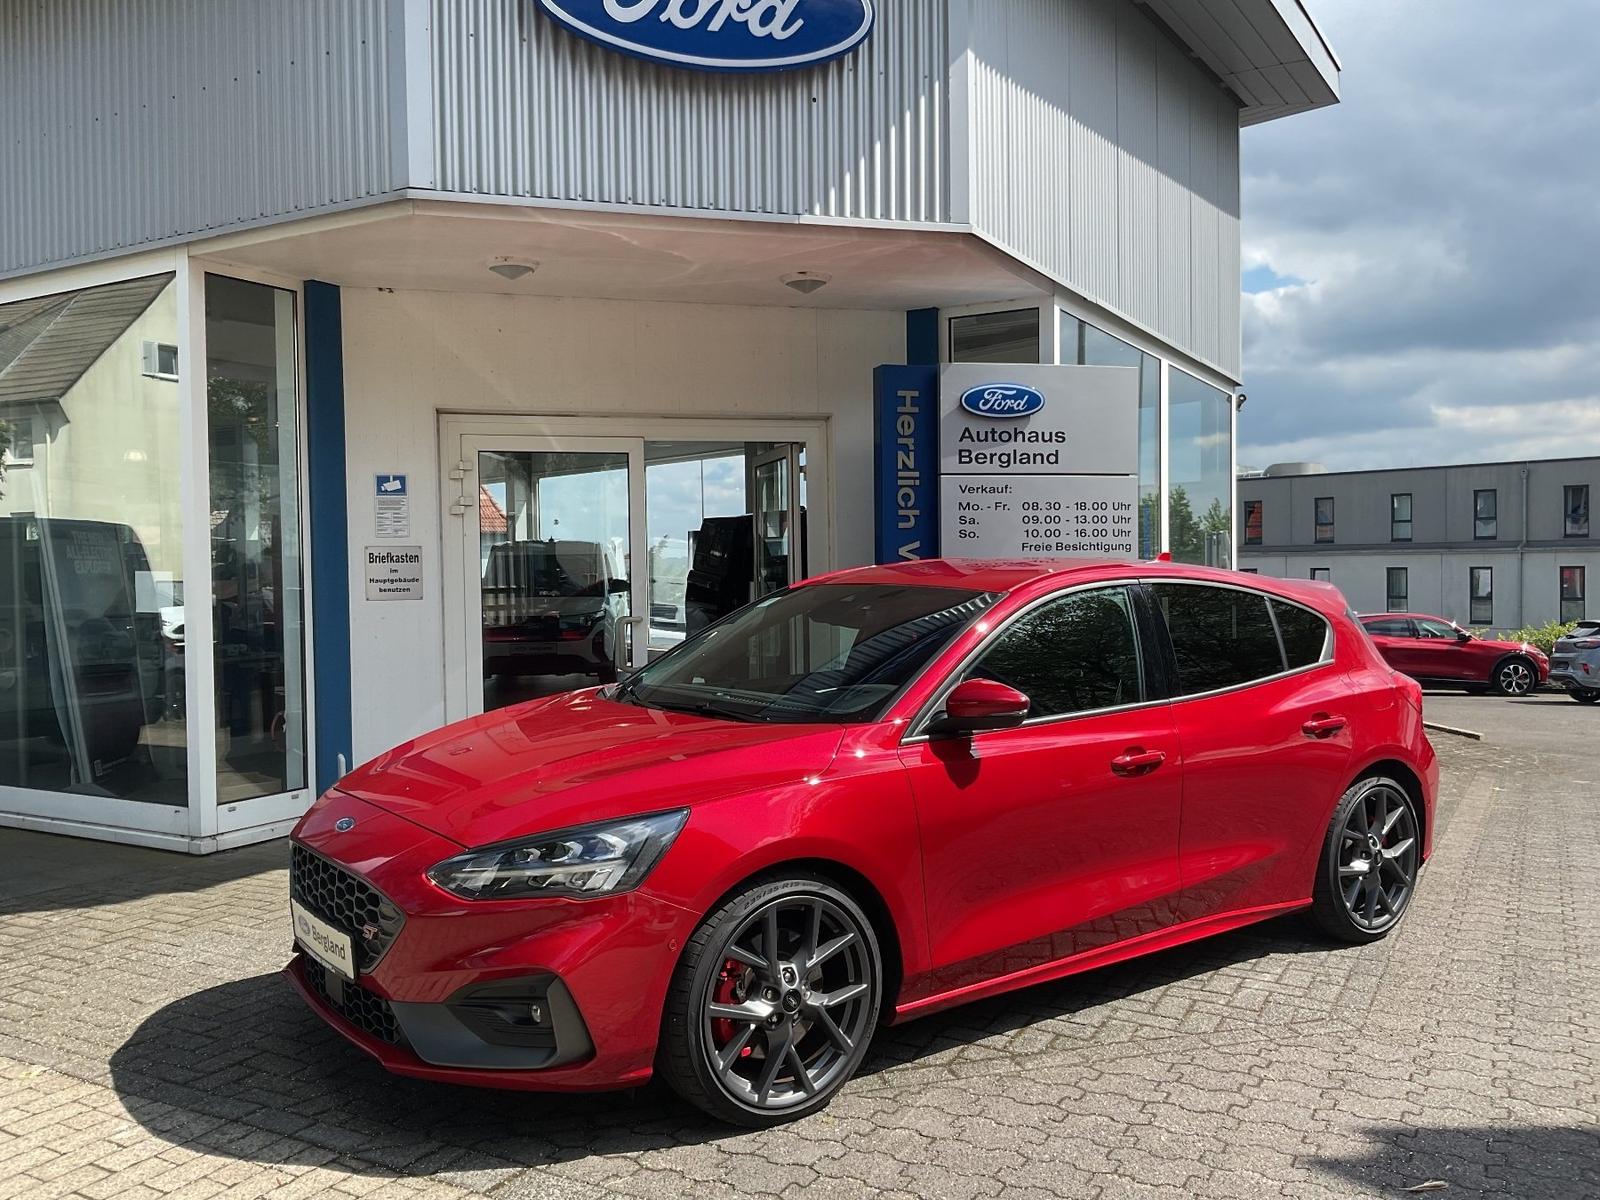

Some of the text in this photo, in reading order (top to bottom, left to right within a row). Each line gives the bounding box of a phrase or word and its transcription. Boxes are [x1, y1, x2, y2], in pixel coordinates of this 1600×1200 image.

[979, 388, 1029, 411] Ford
[958, 427, 1066, 444] Autohaus
[897, 390, 920, 529] Herzlich
[958, 449, 1059, 468] Bergland
[958, 484, 1013, 495] Verkauf:
[958, 501, 983, 511] Mo.
[994, 501, 1011, 511] Fr.
[1021, 501, 1061, 511] 08.30
[1074, 501, 1108, 511] 18.00
[1112, 501, 1132, 511] Uhr
[958, 515, 980, 525] Sa.
[1021, 515, 1061, 525] 09.00
[1074, 515, 1108, 525] 13.00
[1112, 515, 1132, 524] Uhr
[958, 529, 980, 539] So.
[1023, 528, 1061, 538] 10.00
[1074, 528, 1108, 538] 16.00
[1112, 528, 1132, 538] Uhr
[1021, 541, 1132, 553] Freie Besichtigung
[368, 552, 420, 564] Briefkasten
[369, 577, 420, 585] Hauptgebäude
[311, 924, 346, 961] Bergland
